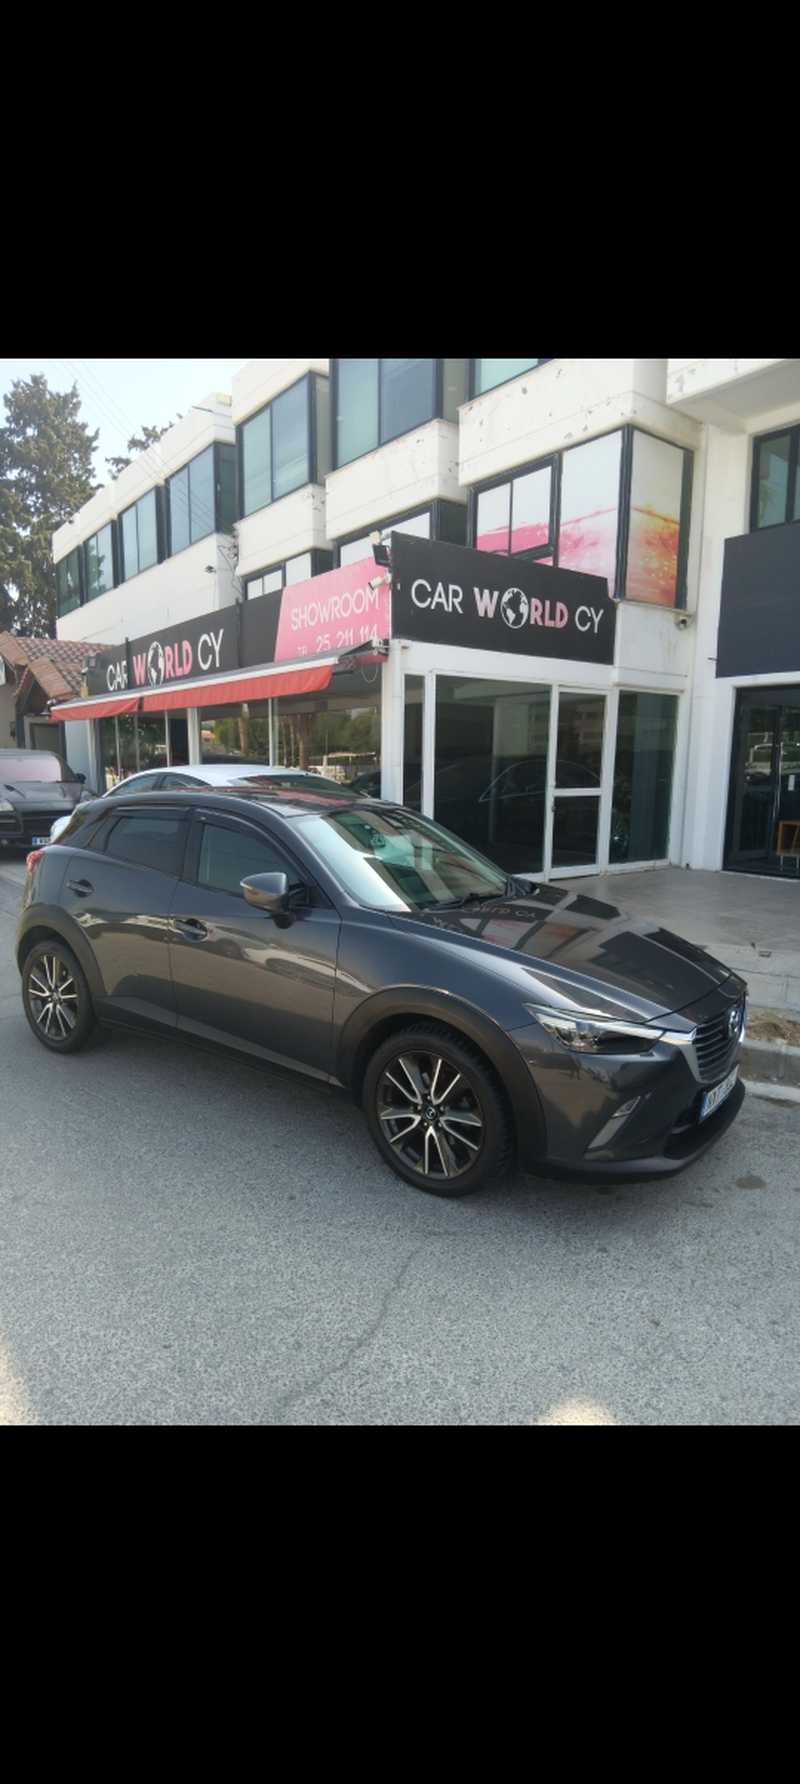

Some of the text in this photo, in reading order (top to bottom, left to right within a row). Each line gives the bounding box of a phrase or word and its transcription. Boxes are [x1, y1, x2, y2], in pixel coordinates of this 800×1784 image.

[290, 587, 380, 631] SHOWROOM
[411, 578, 464, 614] CAR
[574, 605, 604, 633] CY
[197, 628, 224, 671] CY
[315, 631, 331, 655] 25
[336, 627, 354, 648] 211
[360, 623, 378, 643] 114
